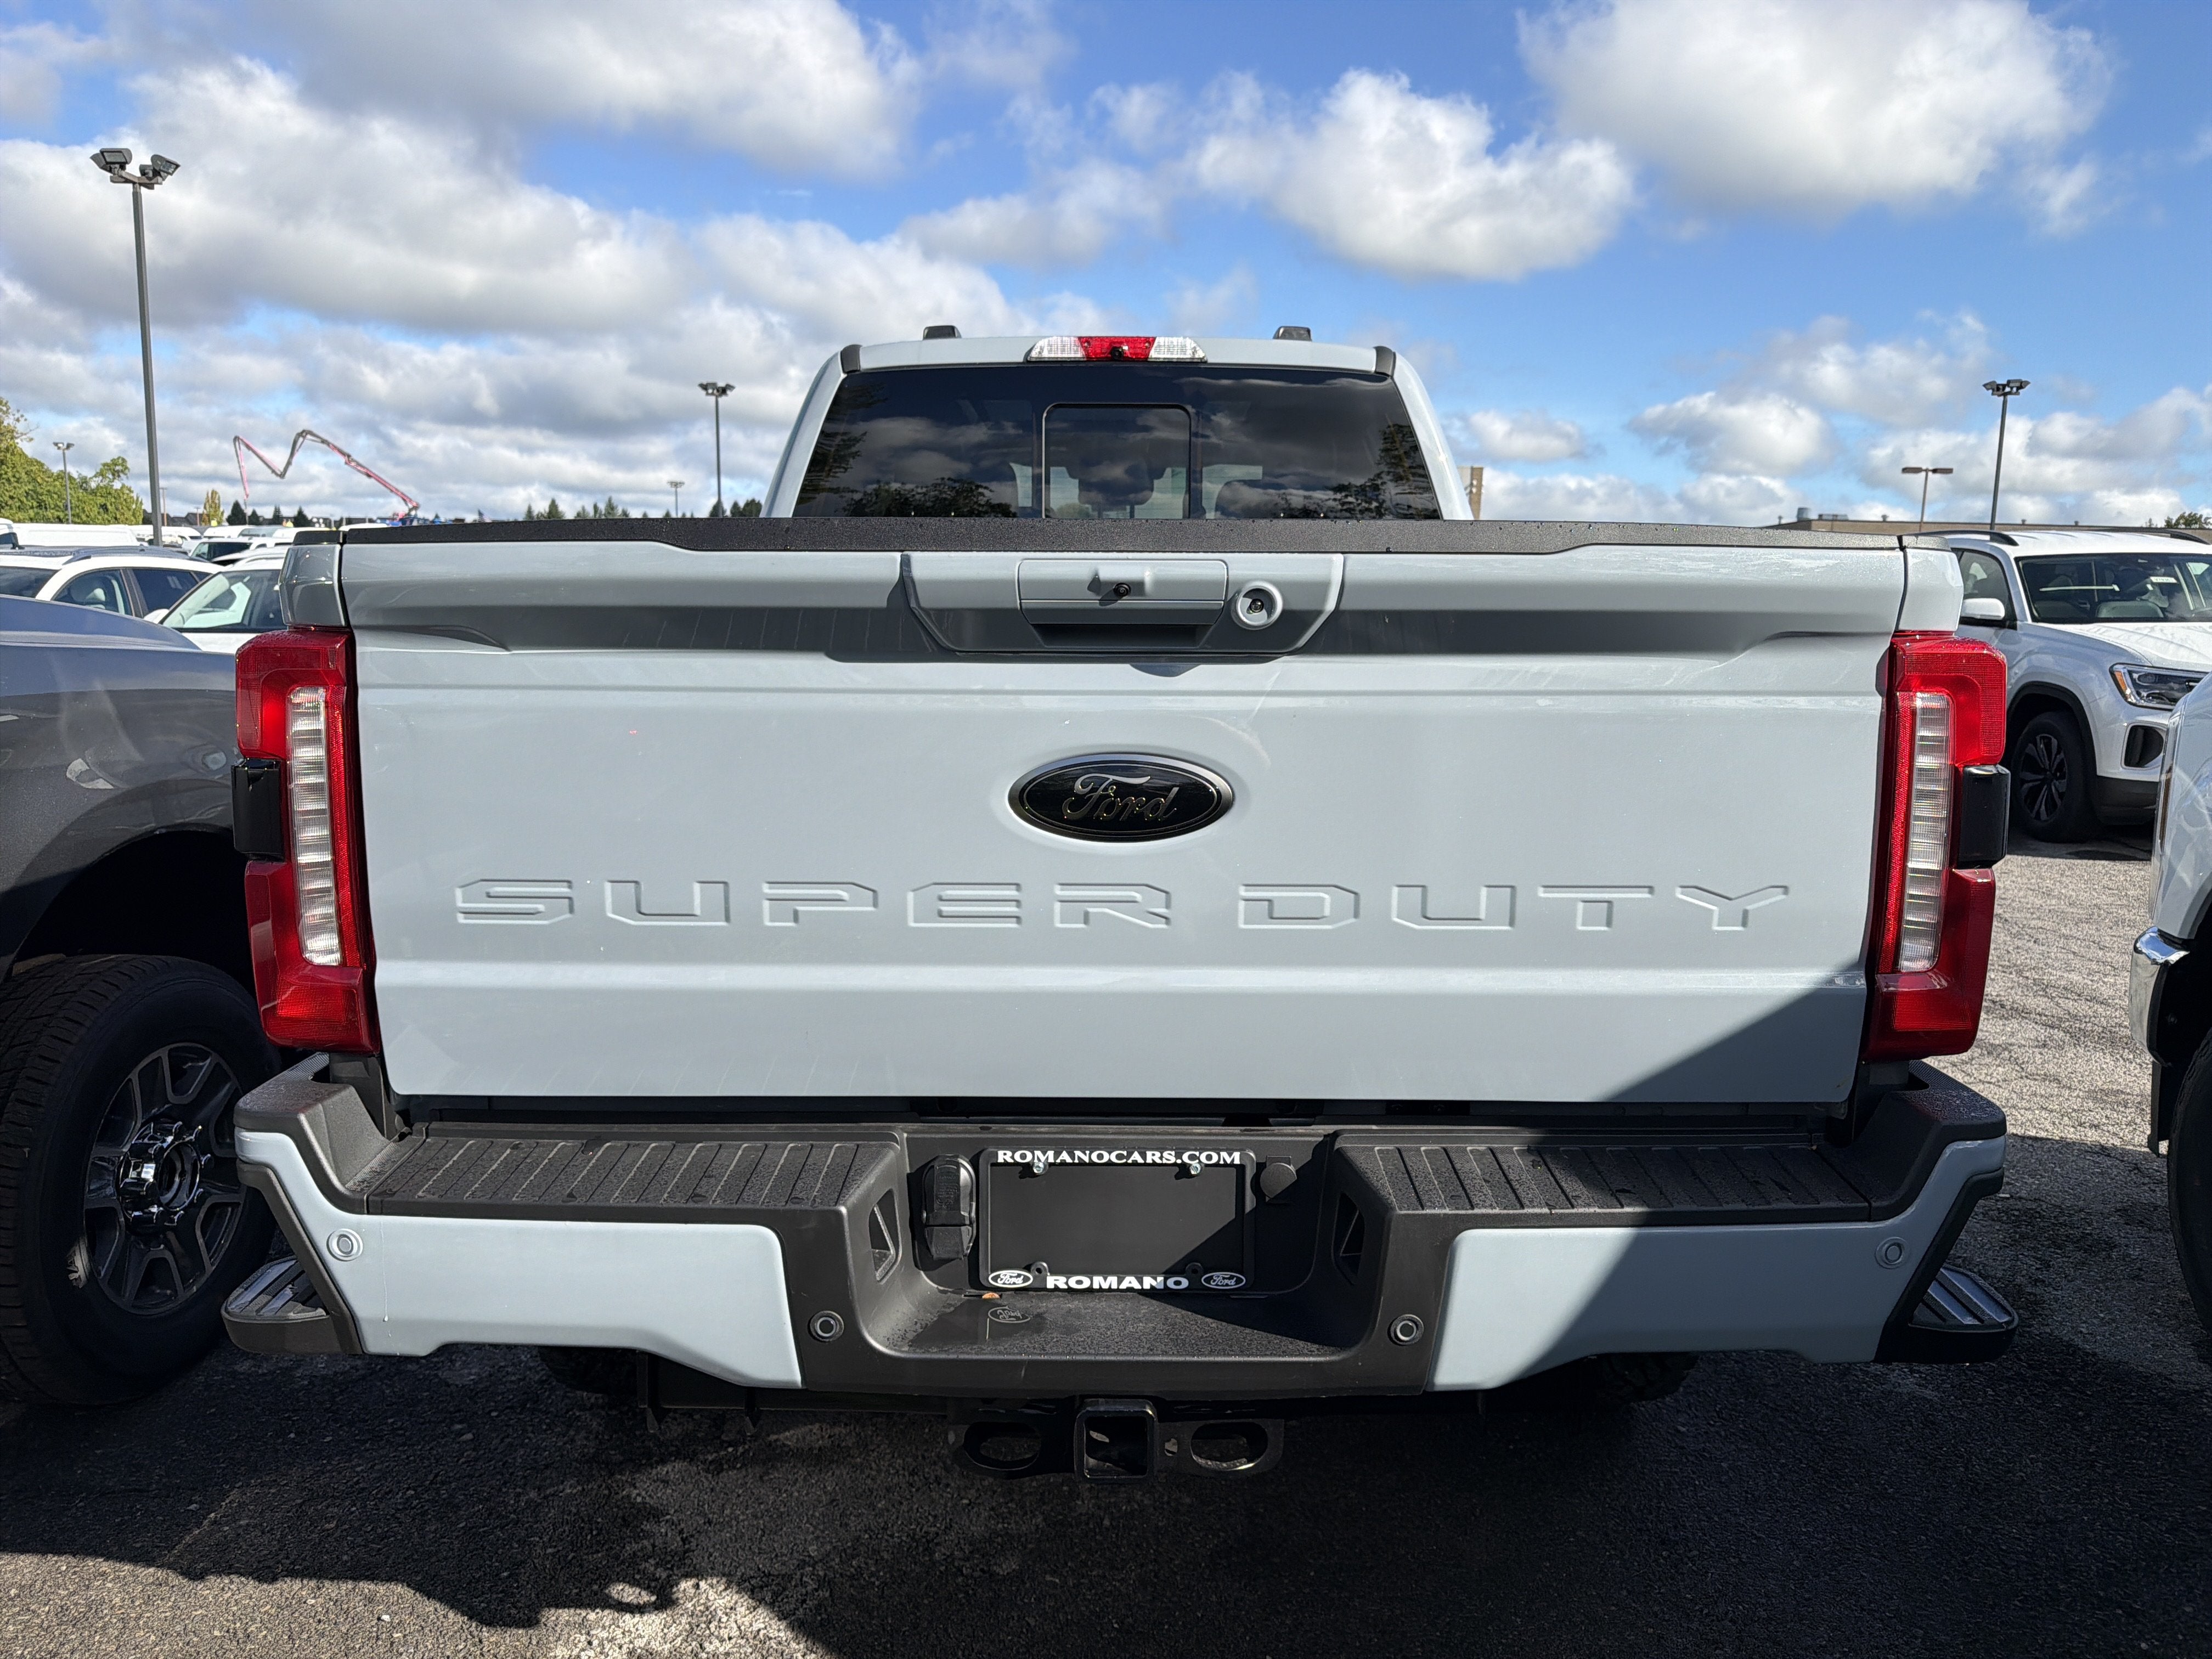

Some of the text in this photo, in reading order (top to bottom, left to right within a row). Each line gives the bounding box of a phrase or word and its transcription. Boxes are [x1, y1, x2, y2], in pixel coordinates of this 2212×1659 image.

[1062, 773, 1180, 821] Ford
[456, 879, 1789, 930] SUPER DUTY
[997, 1150, 1241, 1164] ROMANOCARS.COM
[997, 1273, 1024, 1284] Ford
[1046, 1276, 1189, 1289] ROMANO
[1210, 1274, 1236, 1285] Ford
